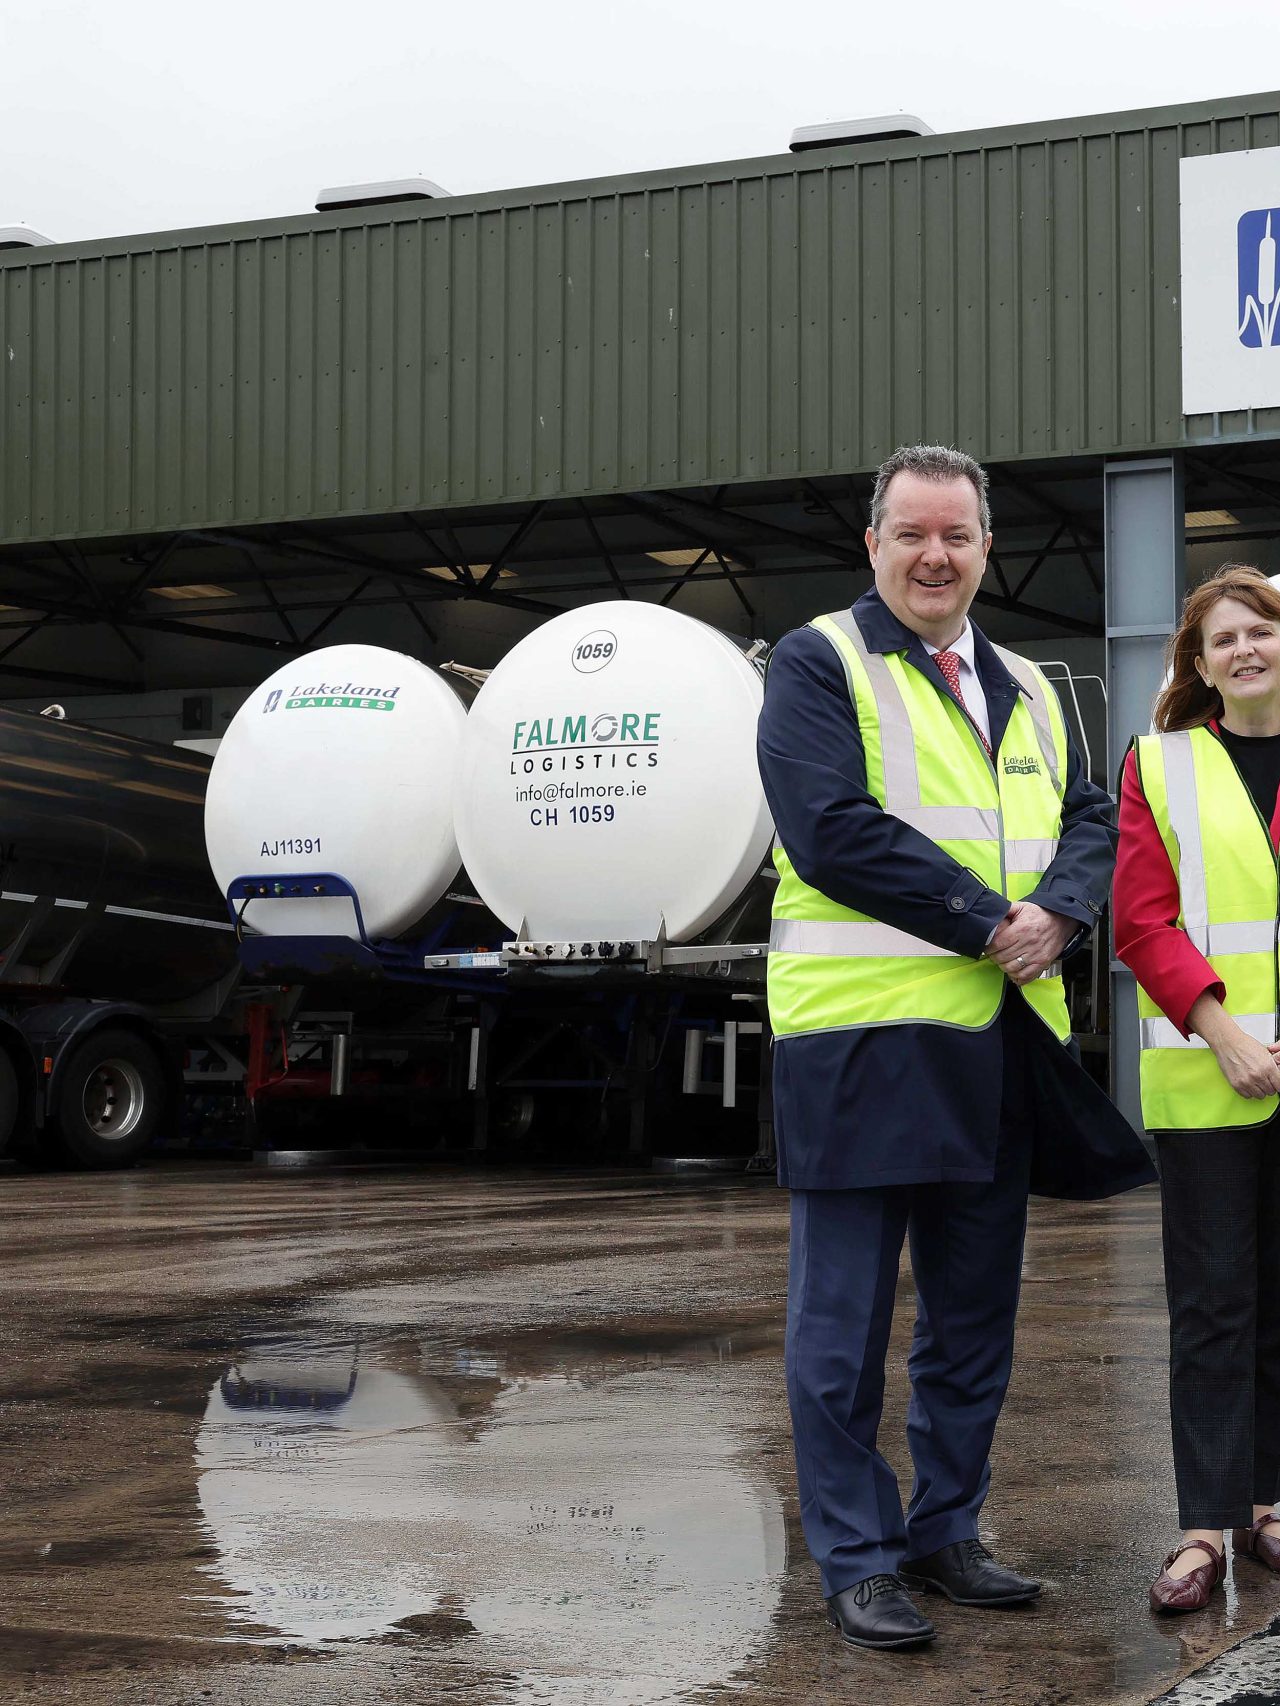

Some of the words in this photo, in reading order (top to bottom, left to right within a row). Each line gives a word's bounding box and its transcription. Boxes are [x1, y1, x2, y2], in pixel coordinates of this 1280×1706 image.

[576, 642, 614, 660] 1059
[289, 683, 401, 699] Lakeland
[291, 698, 387, 709] DAIRIES
[513, 713, 661, 750] FALMORE
[510, 752, 658, 775] LOGISTICS
[515, 780, 647, 802] info@falmore.ie
[530, 808, 558, 826] CH
[569, 804, 615, 823] 1059
[260, 837, 321, 857] AJ11391
